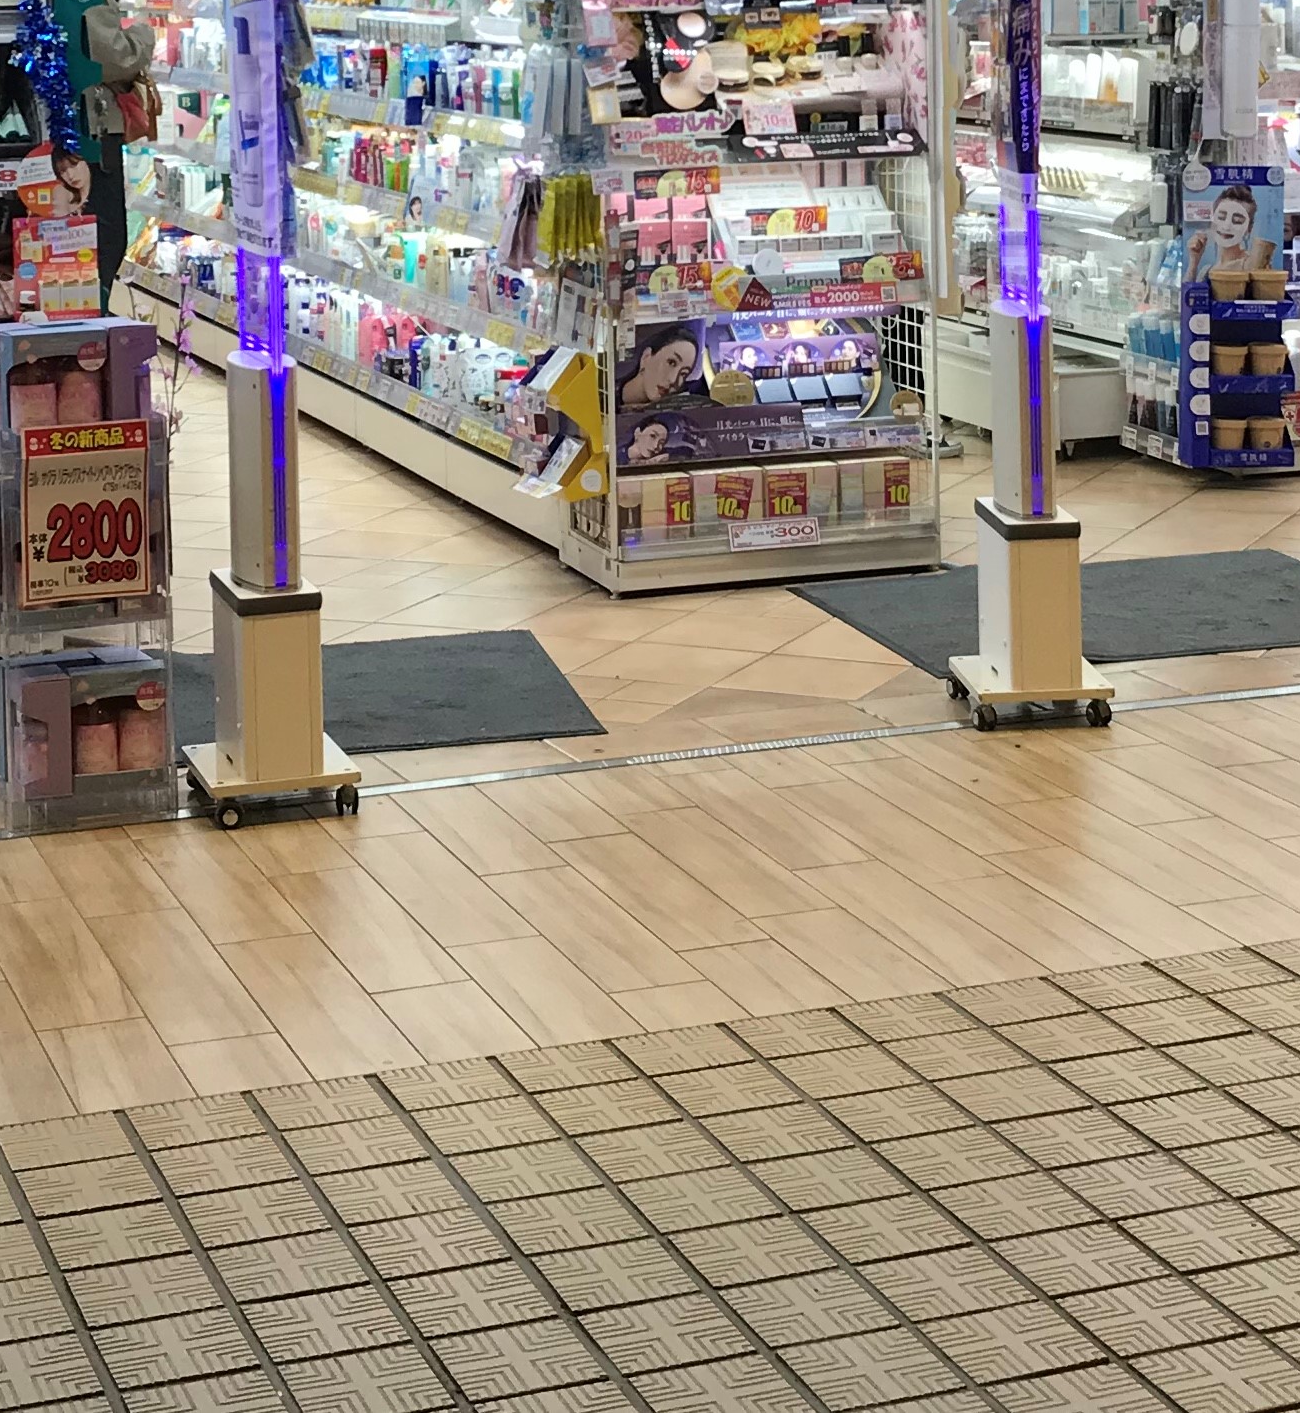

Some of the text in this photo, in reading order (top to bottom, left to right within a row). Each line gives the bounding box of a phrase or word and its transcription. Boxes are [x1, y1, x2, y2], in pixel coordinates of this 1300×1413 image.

[1214, 168, 1253, 181] 雪肌精
[745, 294, 771, 308] NEW
[828, 290, 860, 303] 2000
[49, 427, 125, 450] 冬の新商品
[47, 498, 143, 562] 2800
[775, 525, 814, 538] 300
[29, 534, 48, 545] 本体
[85, 559, 138, 584] 3080
